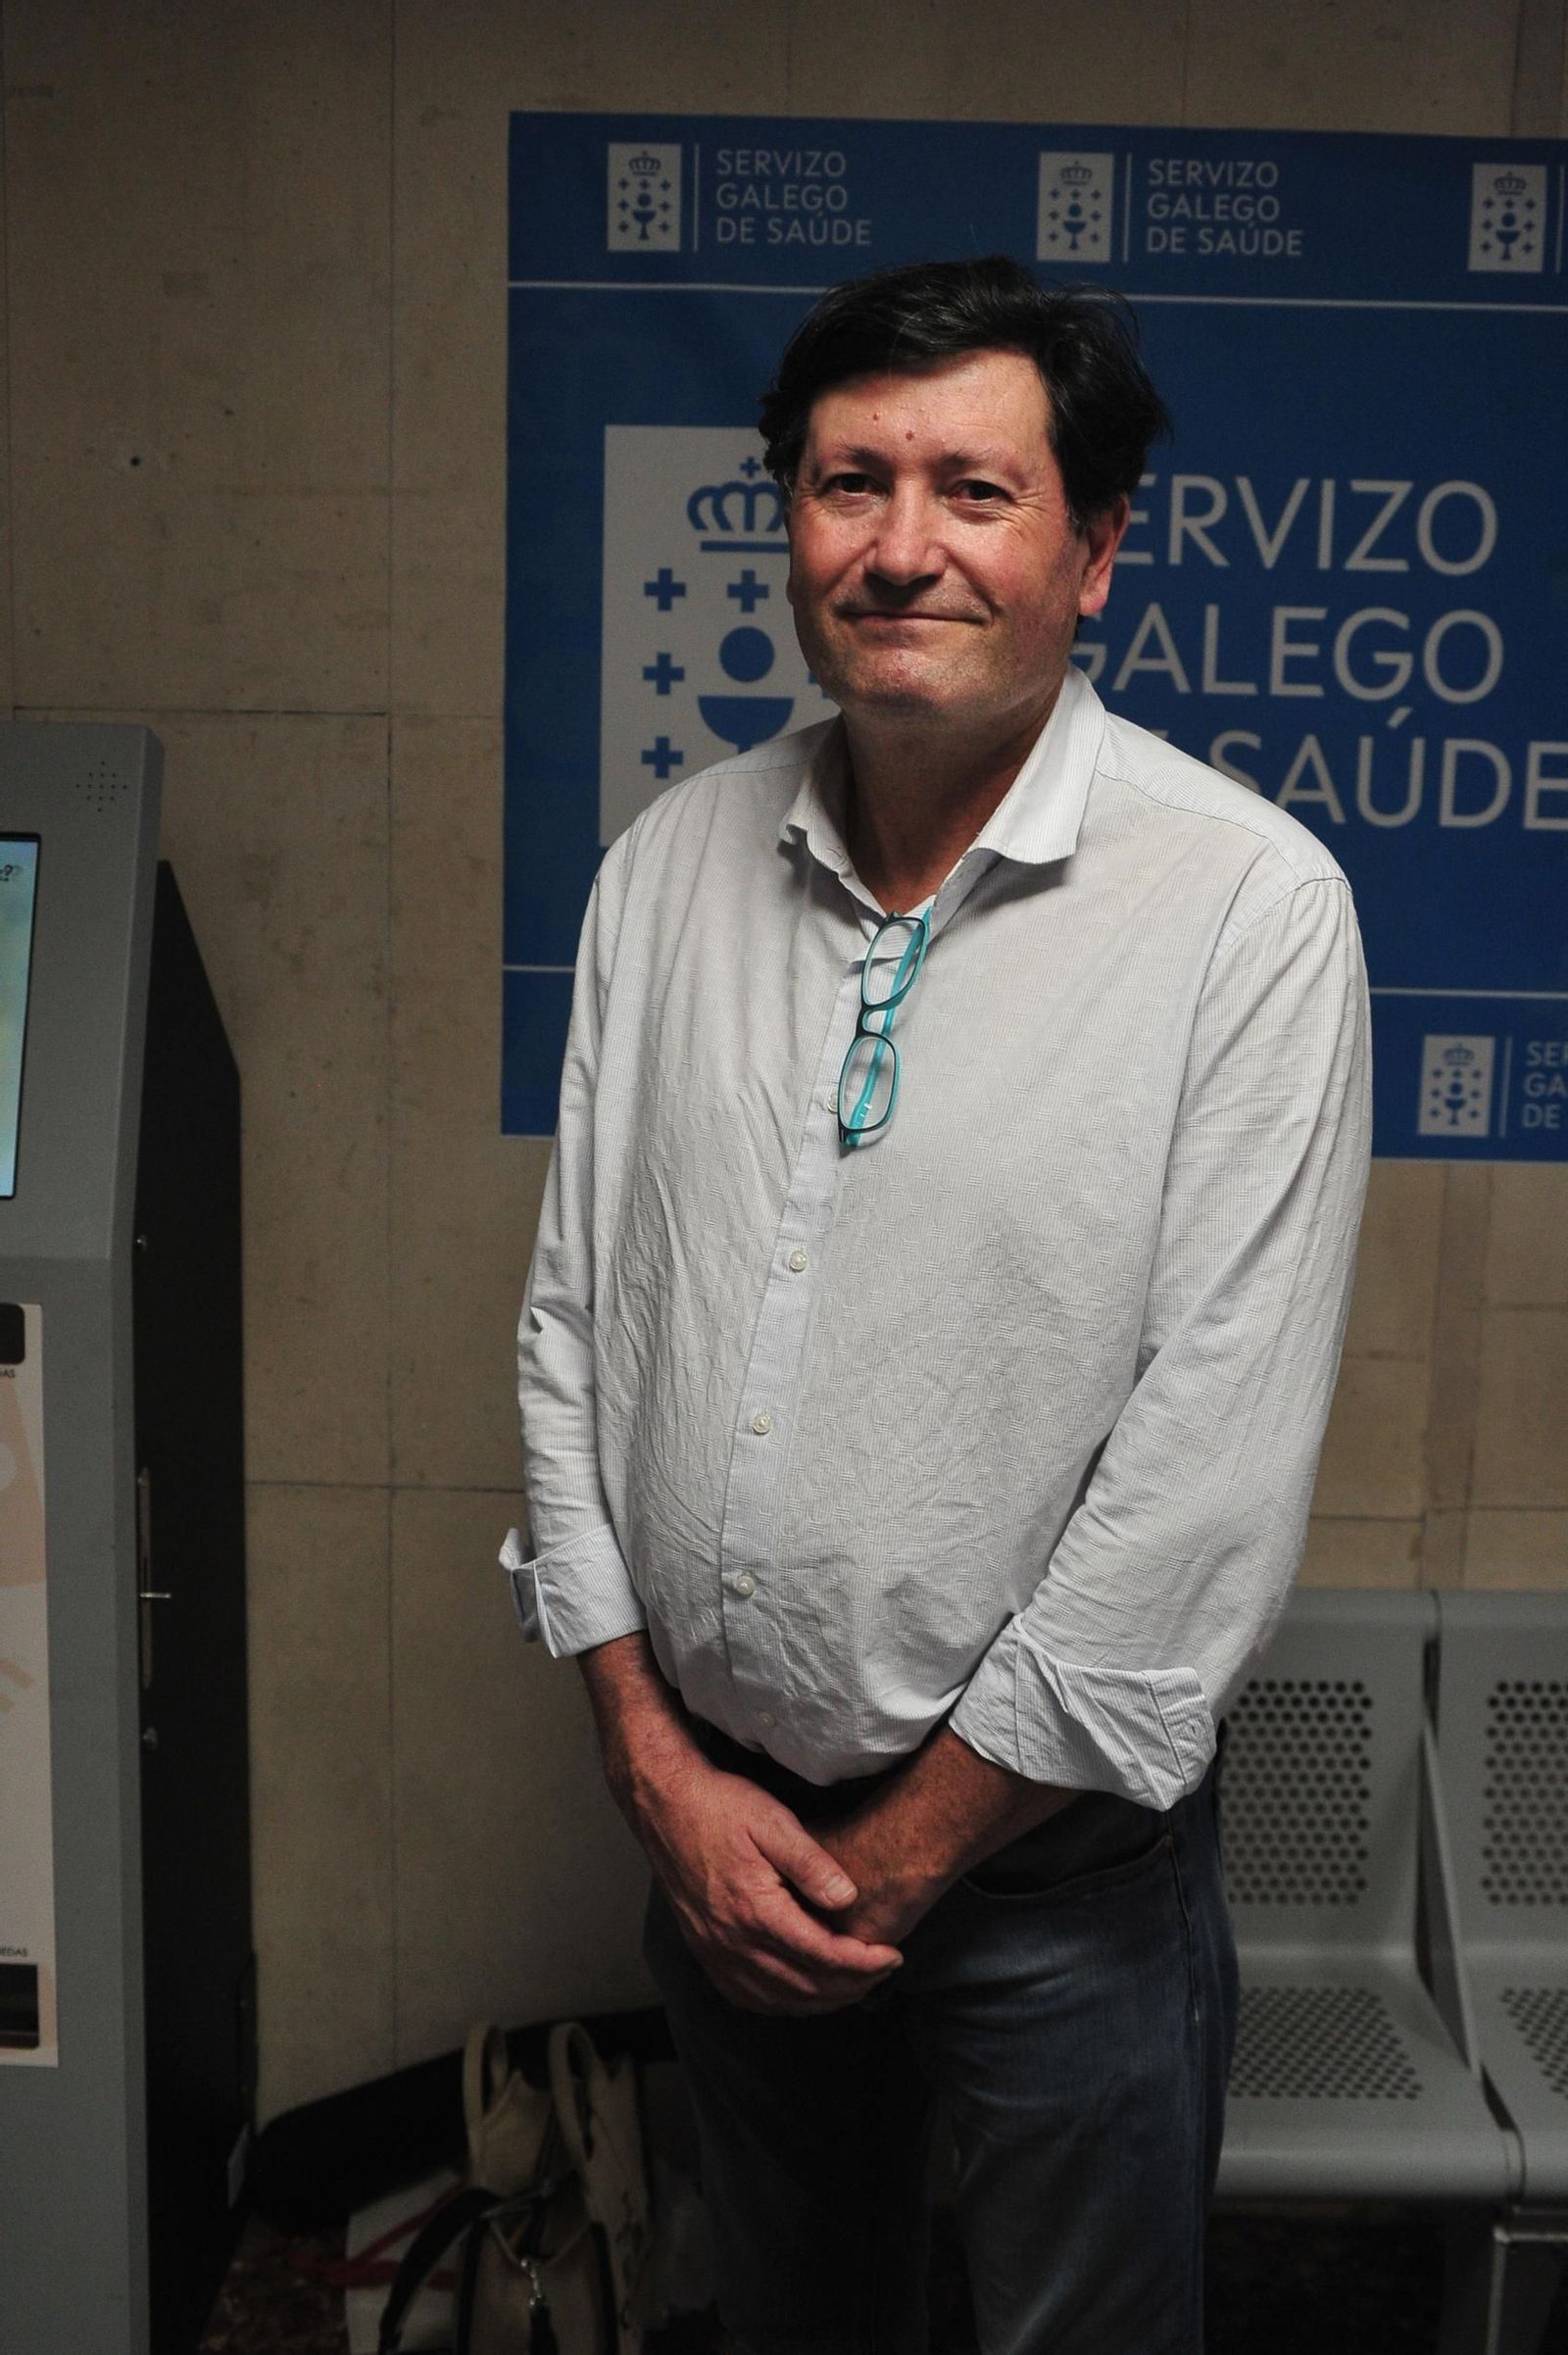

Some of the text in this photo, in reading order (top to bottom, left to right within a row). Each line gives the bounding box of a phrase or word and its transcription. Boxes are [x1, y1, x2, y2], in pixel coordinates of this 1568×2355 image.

[716, 149, 847, 176] SERVIZO
[1148, 159, 1279, 188] SERVIZO
[716, 182, 848, 211] GALEGO
[1148, 192, 1279, 221] GALEGO
[716, 212, 871, 246] DE SAÚDE
[1147, 221, 1302, 256] DE SAÚDE
[1113, 472, 1498, 576] ERVIZO
[1208, 706, 1568, 831] SAÚDE
[1522, 1103, 1560, 1129] DE
